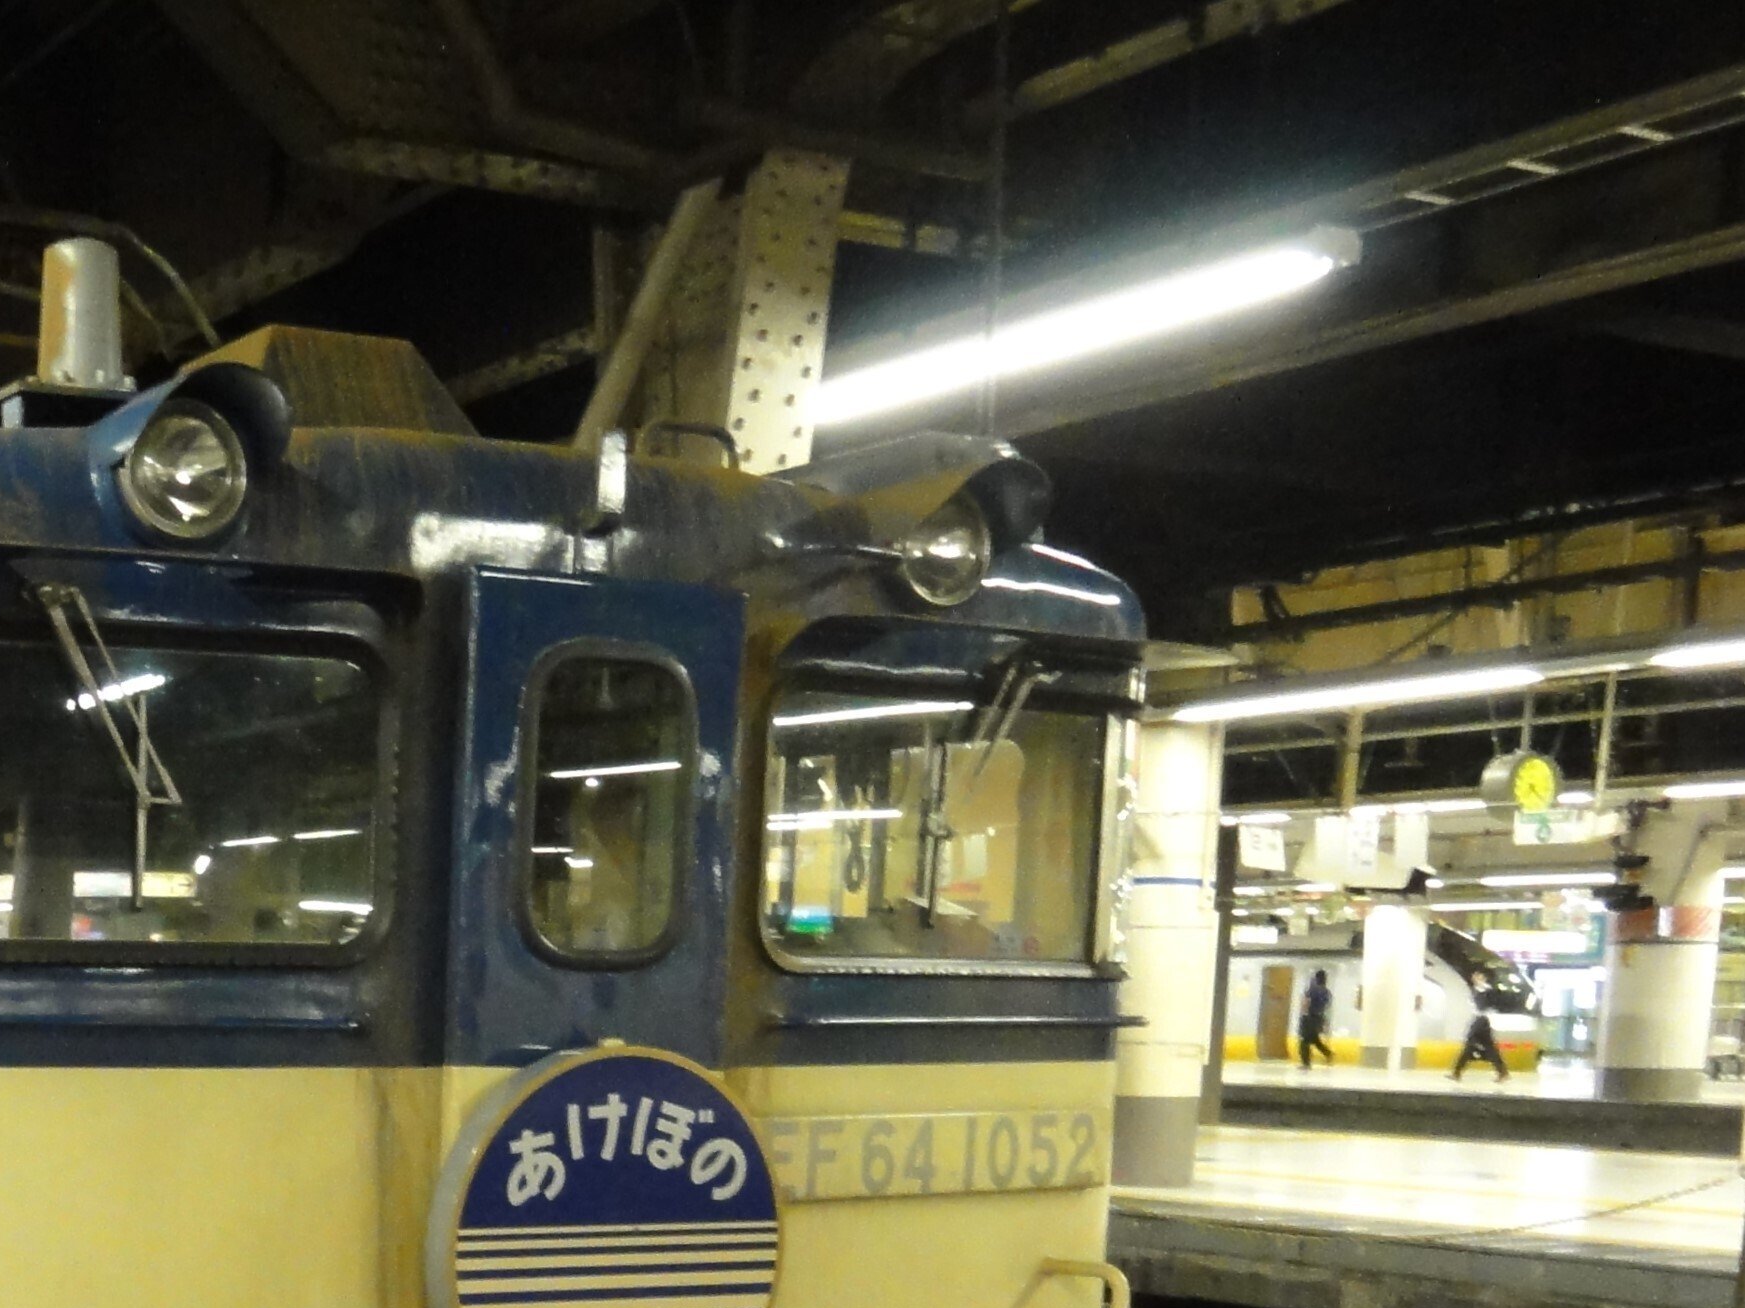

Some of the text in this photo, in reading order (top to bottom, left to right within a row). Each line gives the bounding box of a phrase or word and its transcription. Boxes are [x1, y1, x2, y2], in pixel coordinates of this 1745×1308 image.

[506, 1093, 748, 1207] あけぼの
[962, 1111, 1097, 1193] 1052
